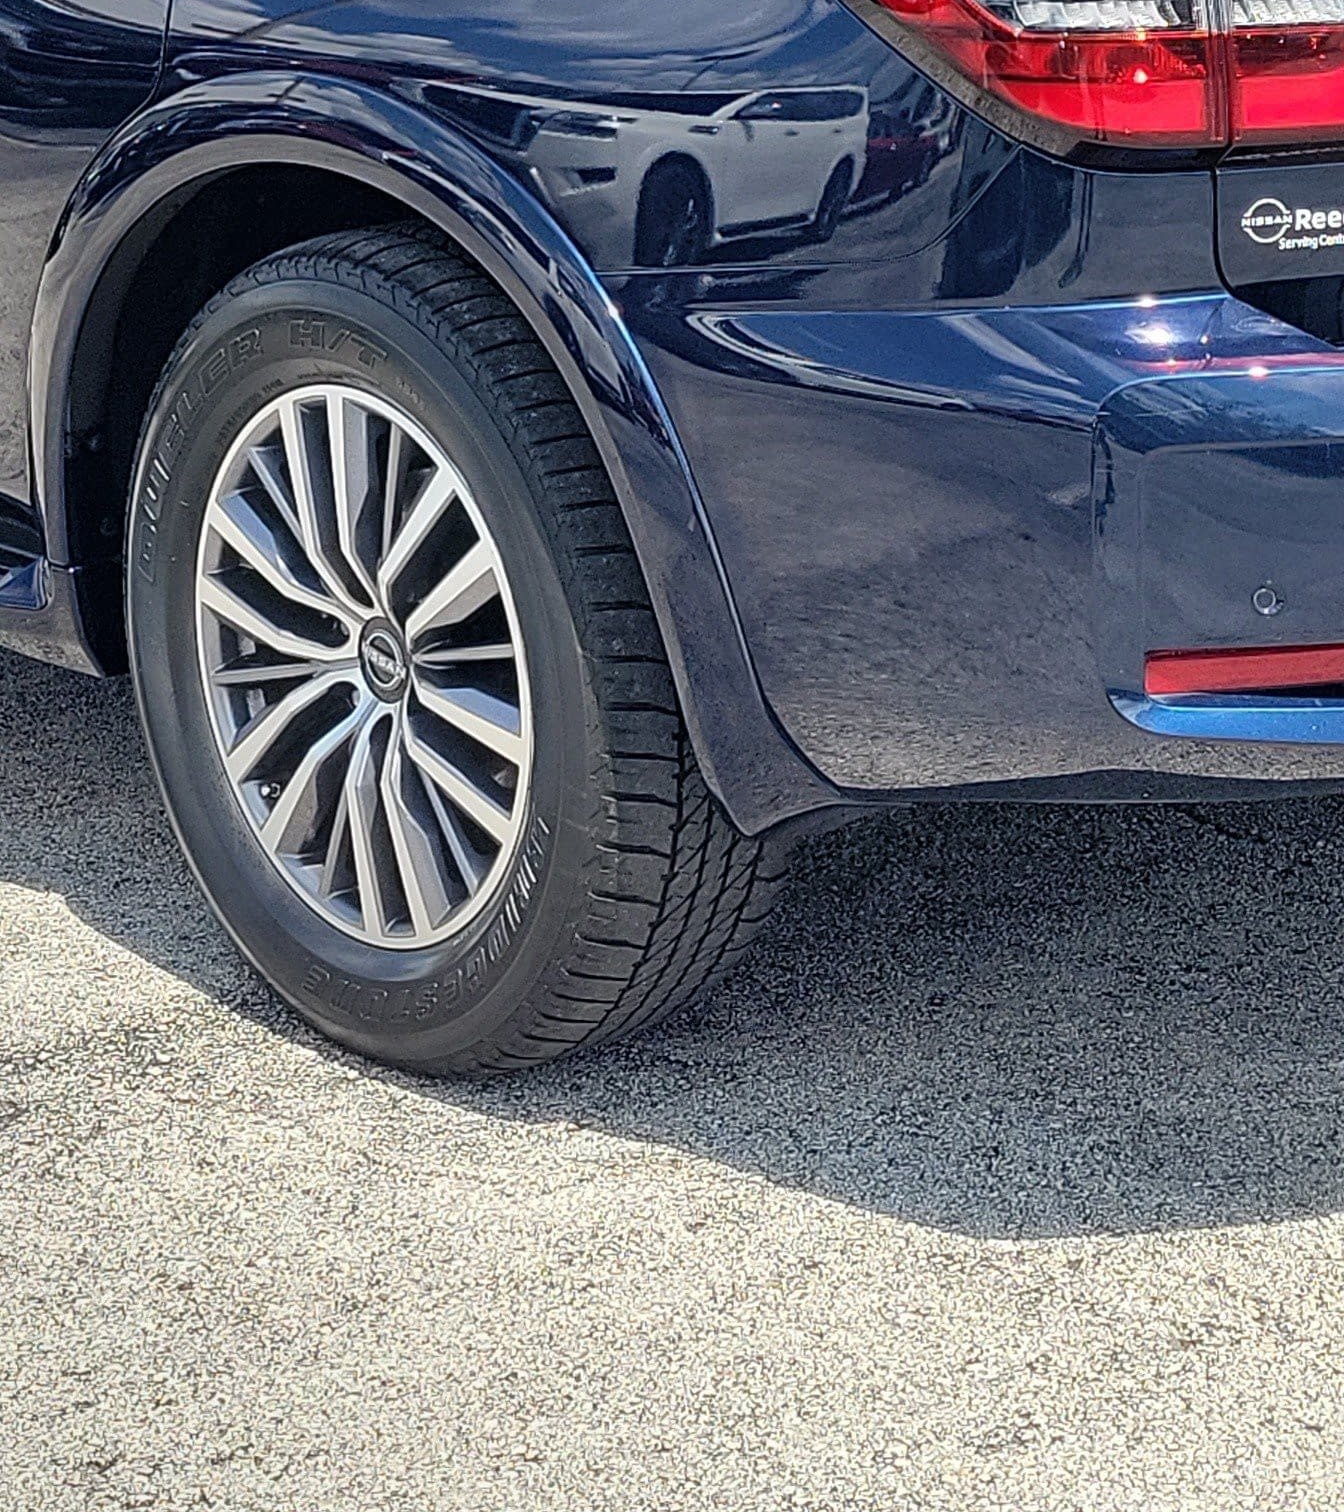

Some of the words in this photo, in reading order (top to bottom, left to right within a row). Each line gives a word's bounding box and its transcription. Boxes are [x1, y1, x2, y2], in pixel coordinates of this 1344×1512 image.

[1241, 213, 1293, 227] NISSAN
[1278, 235, 1319, 251] Serving
[288, 318, 389, 369] H/T
